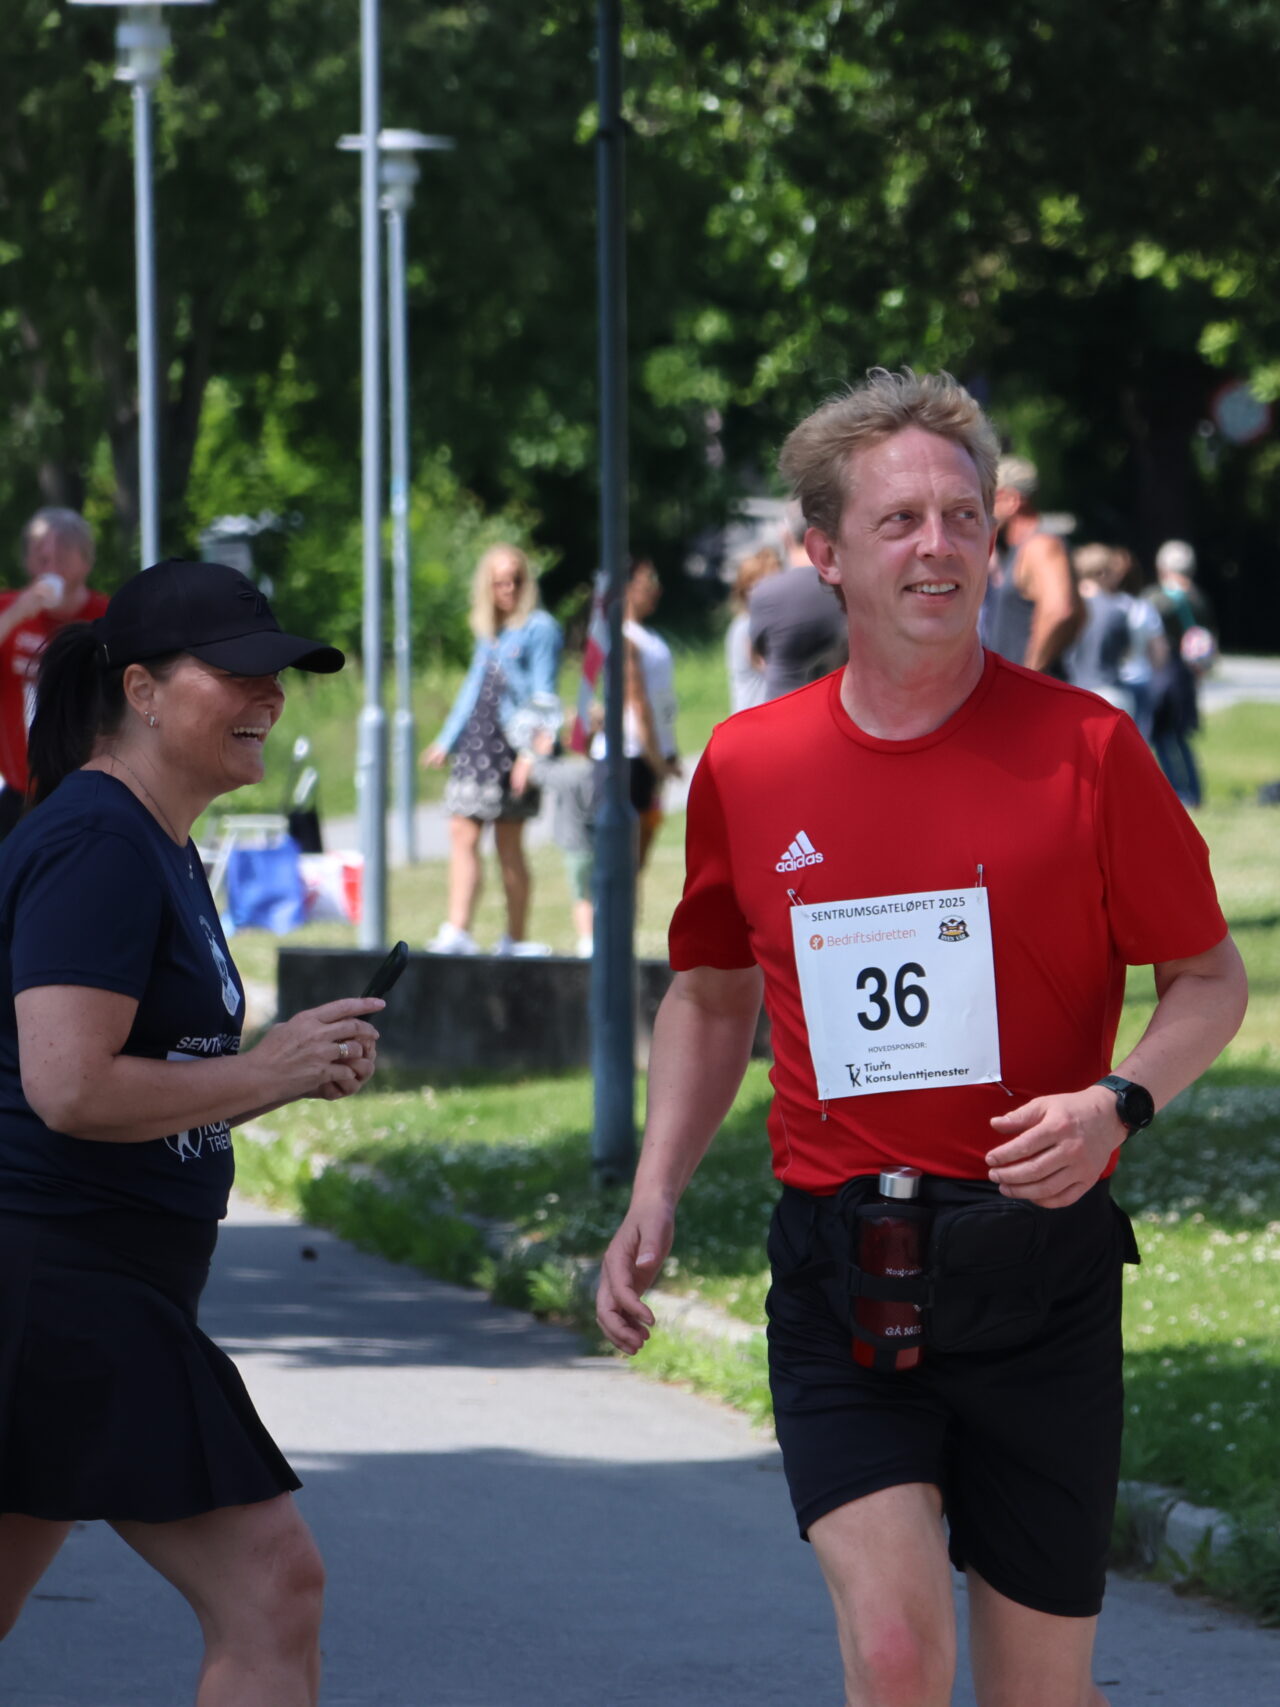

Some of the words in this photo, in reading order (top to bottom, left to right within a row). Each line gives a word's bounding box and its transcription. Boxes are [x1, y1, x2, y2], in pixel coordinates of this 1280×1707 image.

[775, 851, 824, 873] adidas
[811, 899, 935, 922] SENTRUMSGATELØPET
[938, 896, 966, 909] 2025
[827, 928, 916, 947] Bedriftsidretten
[856, 962, 930, 1031] 36
[868, 1042, 928, 1054] HOVEDSPONSOR:
[865, 1067, 969, 1085] Konsulenttjenester
